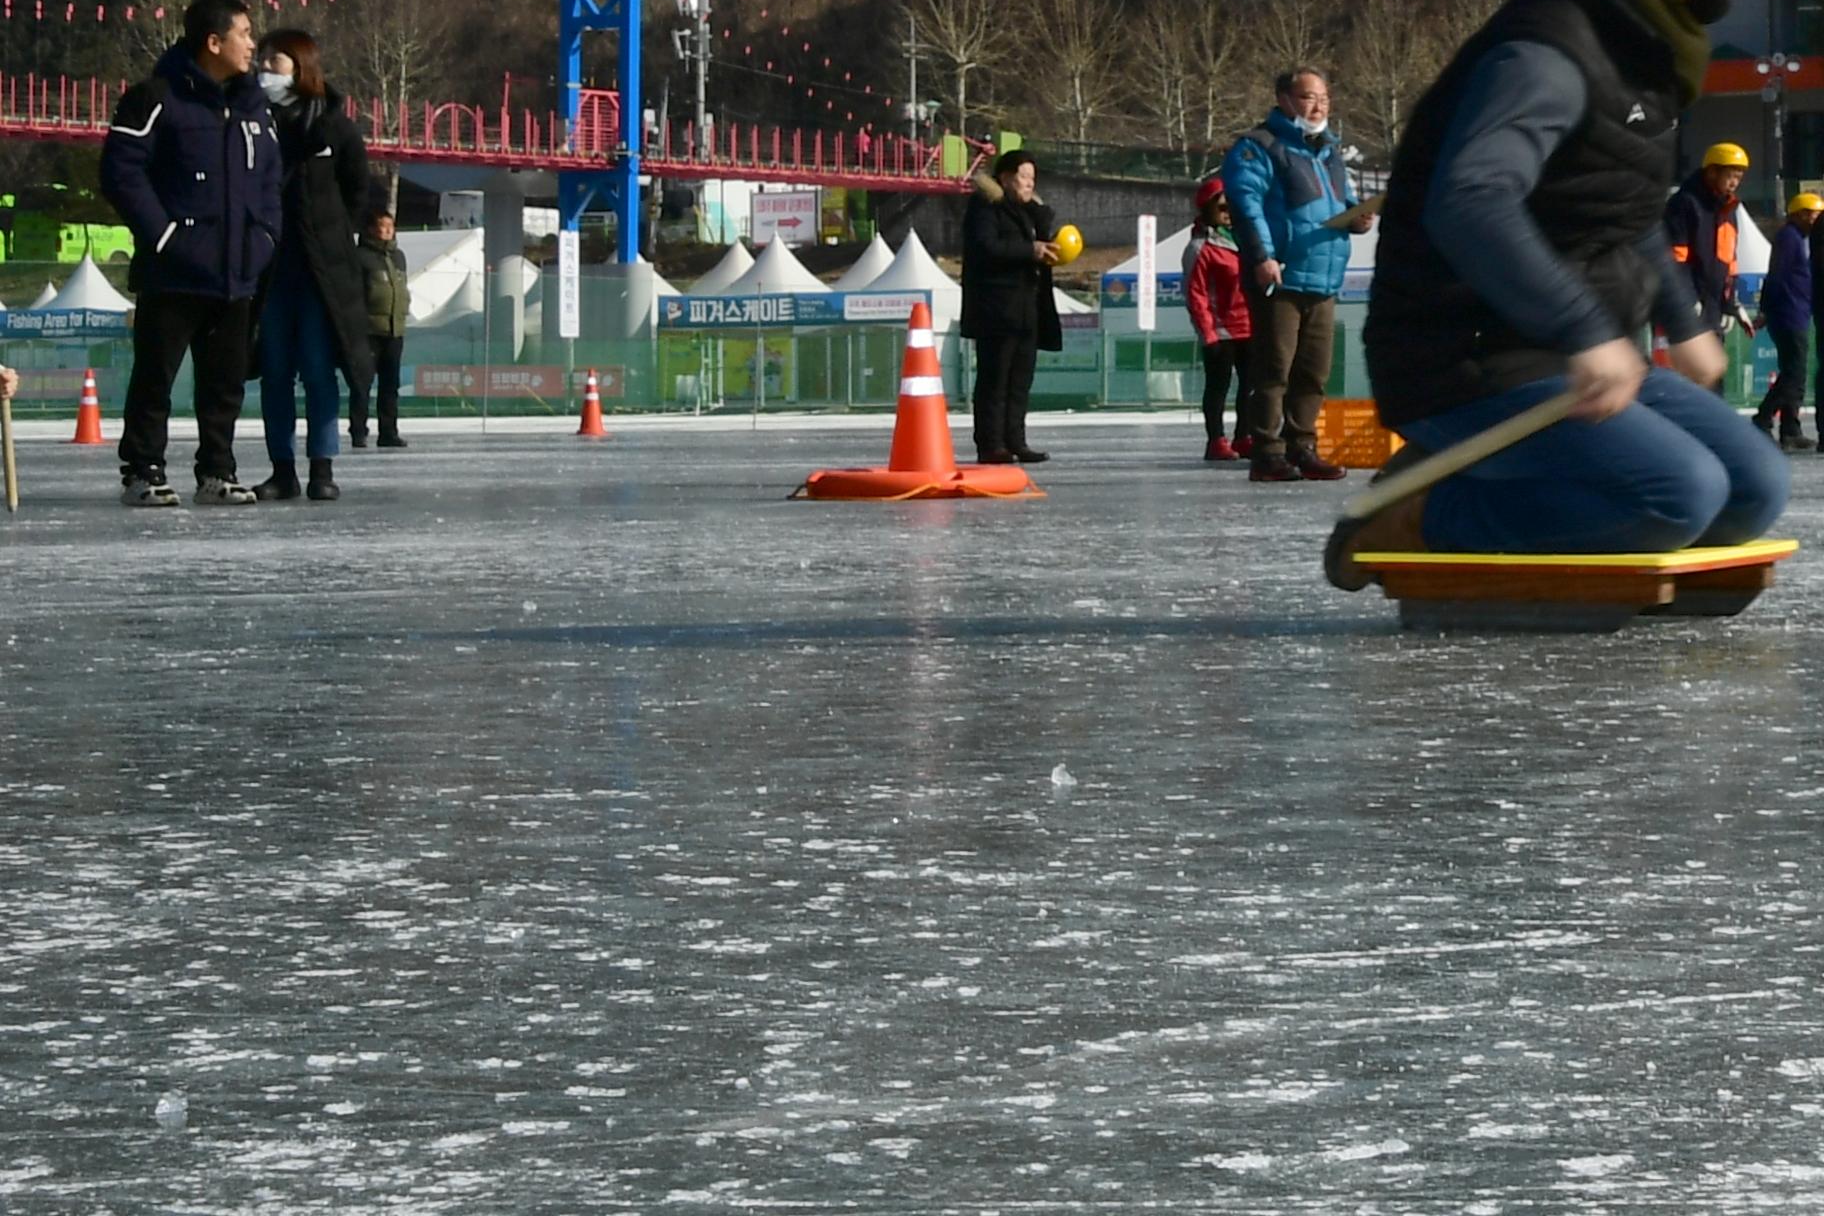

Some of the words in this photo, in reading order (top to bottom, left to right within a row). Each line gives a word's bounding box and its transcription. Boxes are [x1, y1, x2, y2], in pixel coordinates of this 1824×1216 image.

[7, 313, 42, 329] Fishing
[44, 312, 67, 328] Area
[69, 311, 83, 326] for
[689, 298, 795, 323] 피겨스케이트
